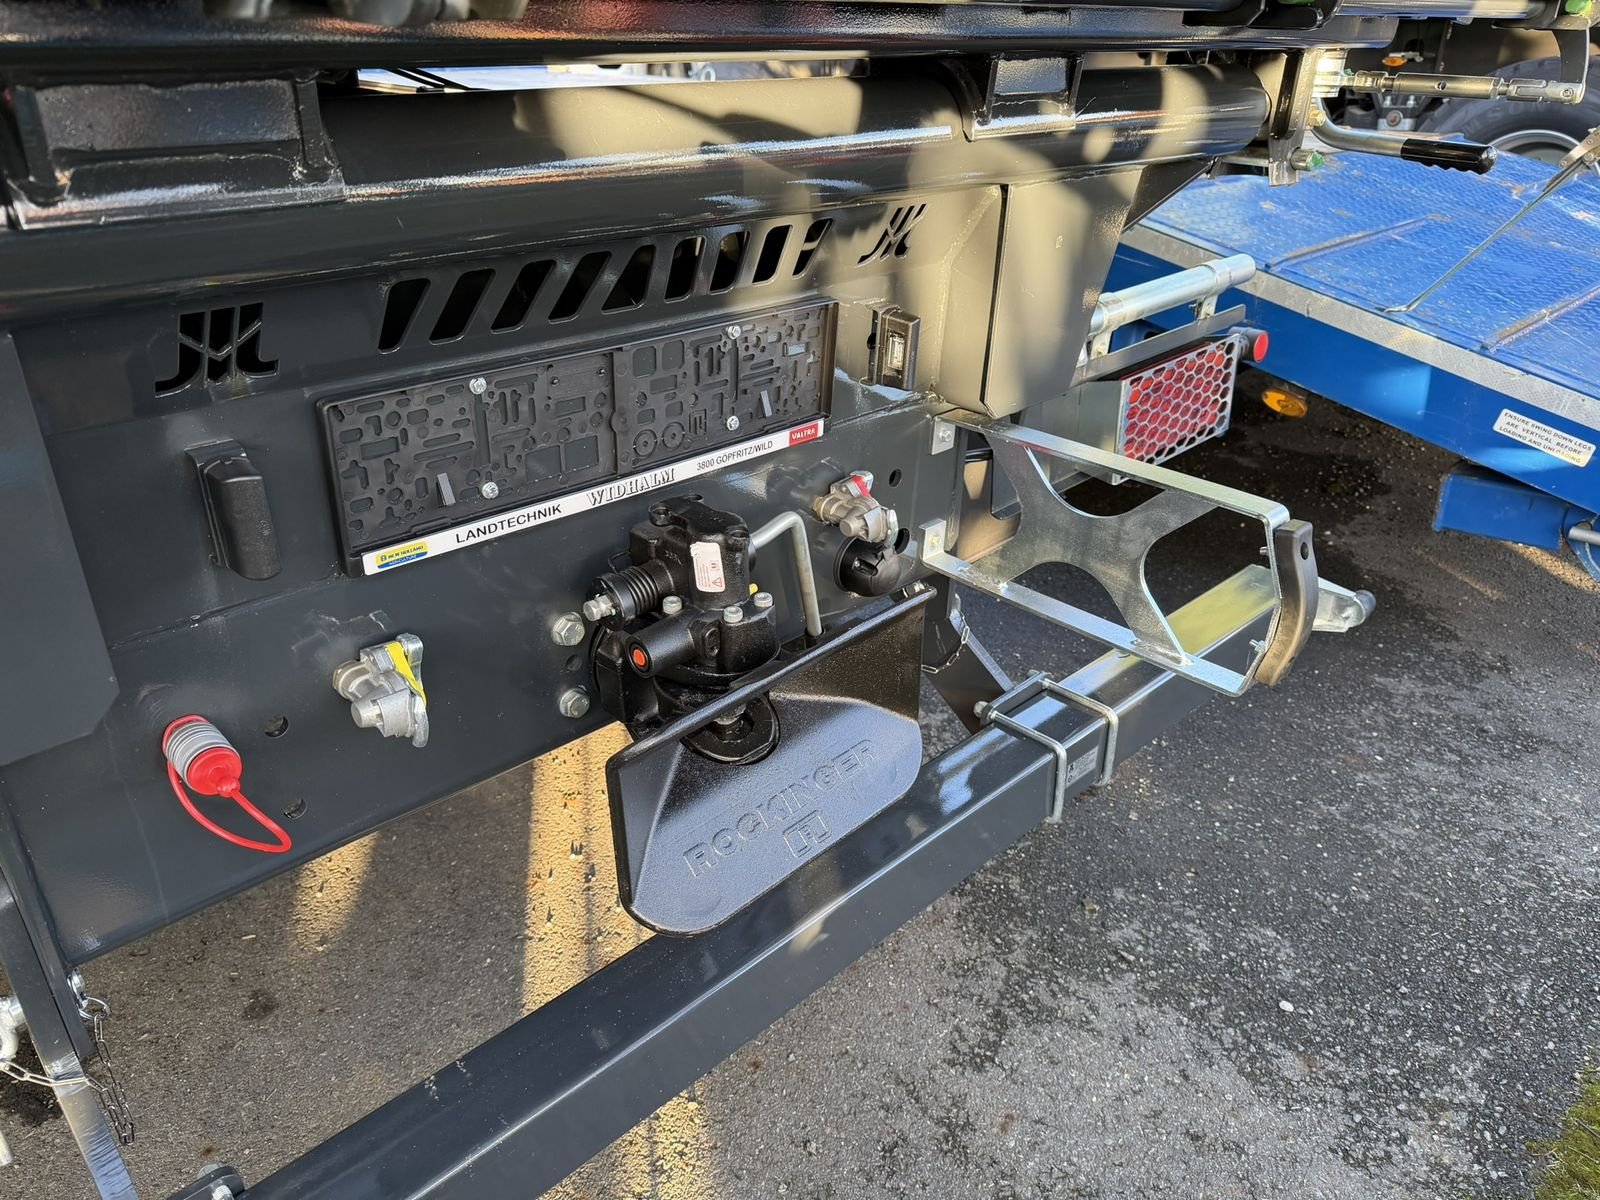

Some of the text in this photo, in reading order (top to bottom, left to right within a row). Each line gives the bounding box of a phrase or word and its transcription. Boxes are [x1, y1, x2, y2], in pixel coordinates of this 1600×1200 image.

[791, 428, 816, 440] VALTRA
[1499, 426, 1581, 463] LOADING AND UNLOADING
[1504, 412, 1592, 451] ENSURE SWING DOWN LEGS
[1506, 421, 1582, 455] ARE VERTICAL BEFORE
[456, 504, 562, 543] LANDTECHNIK
[587, 468, 675, 506] WIDHALM
[696, 459, 715, 471] 3800
[682, 739, 880, 878] ROCKINGER
